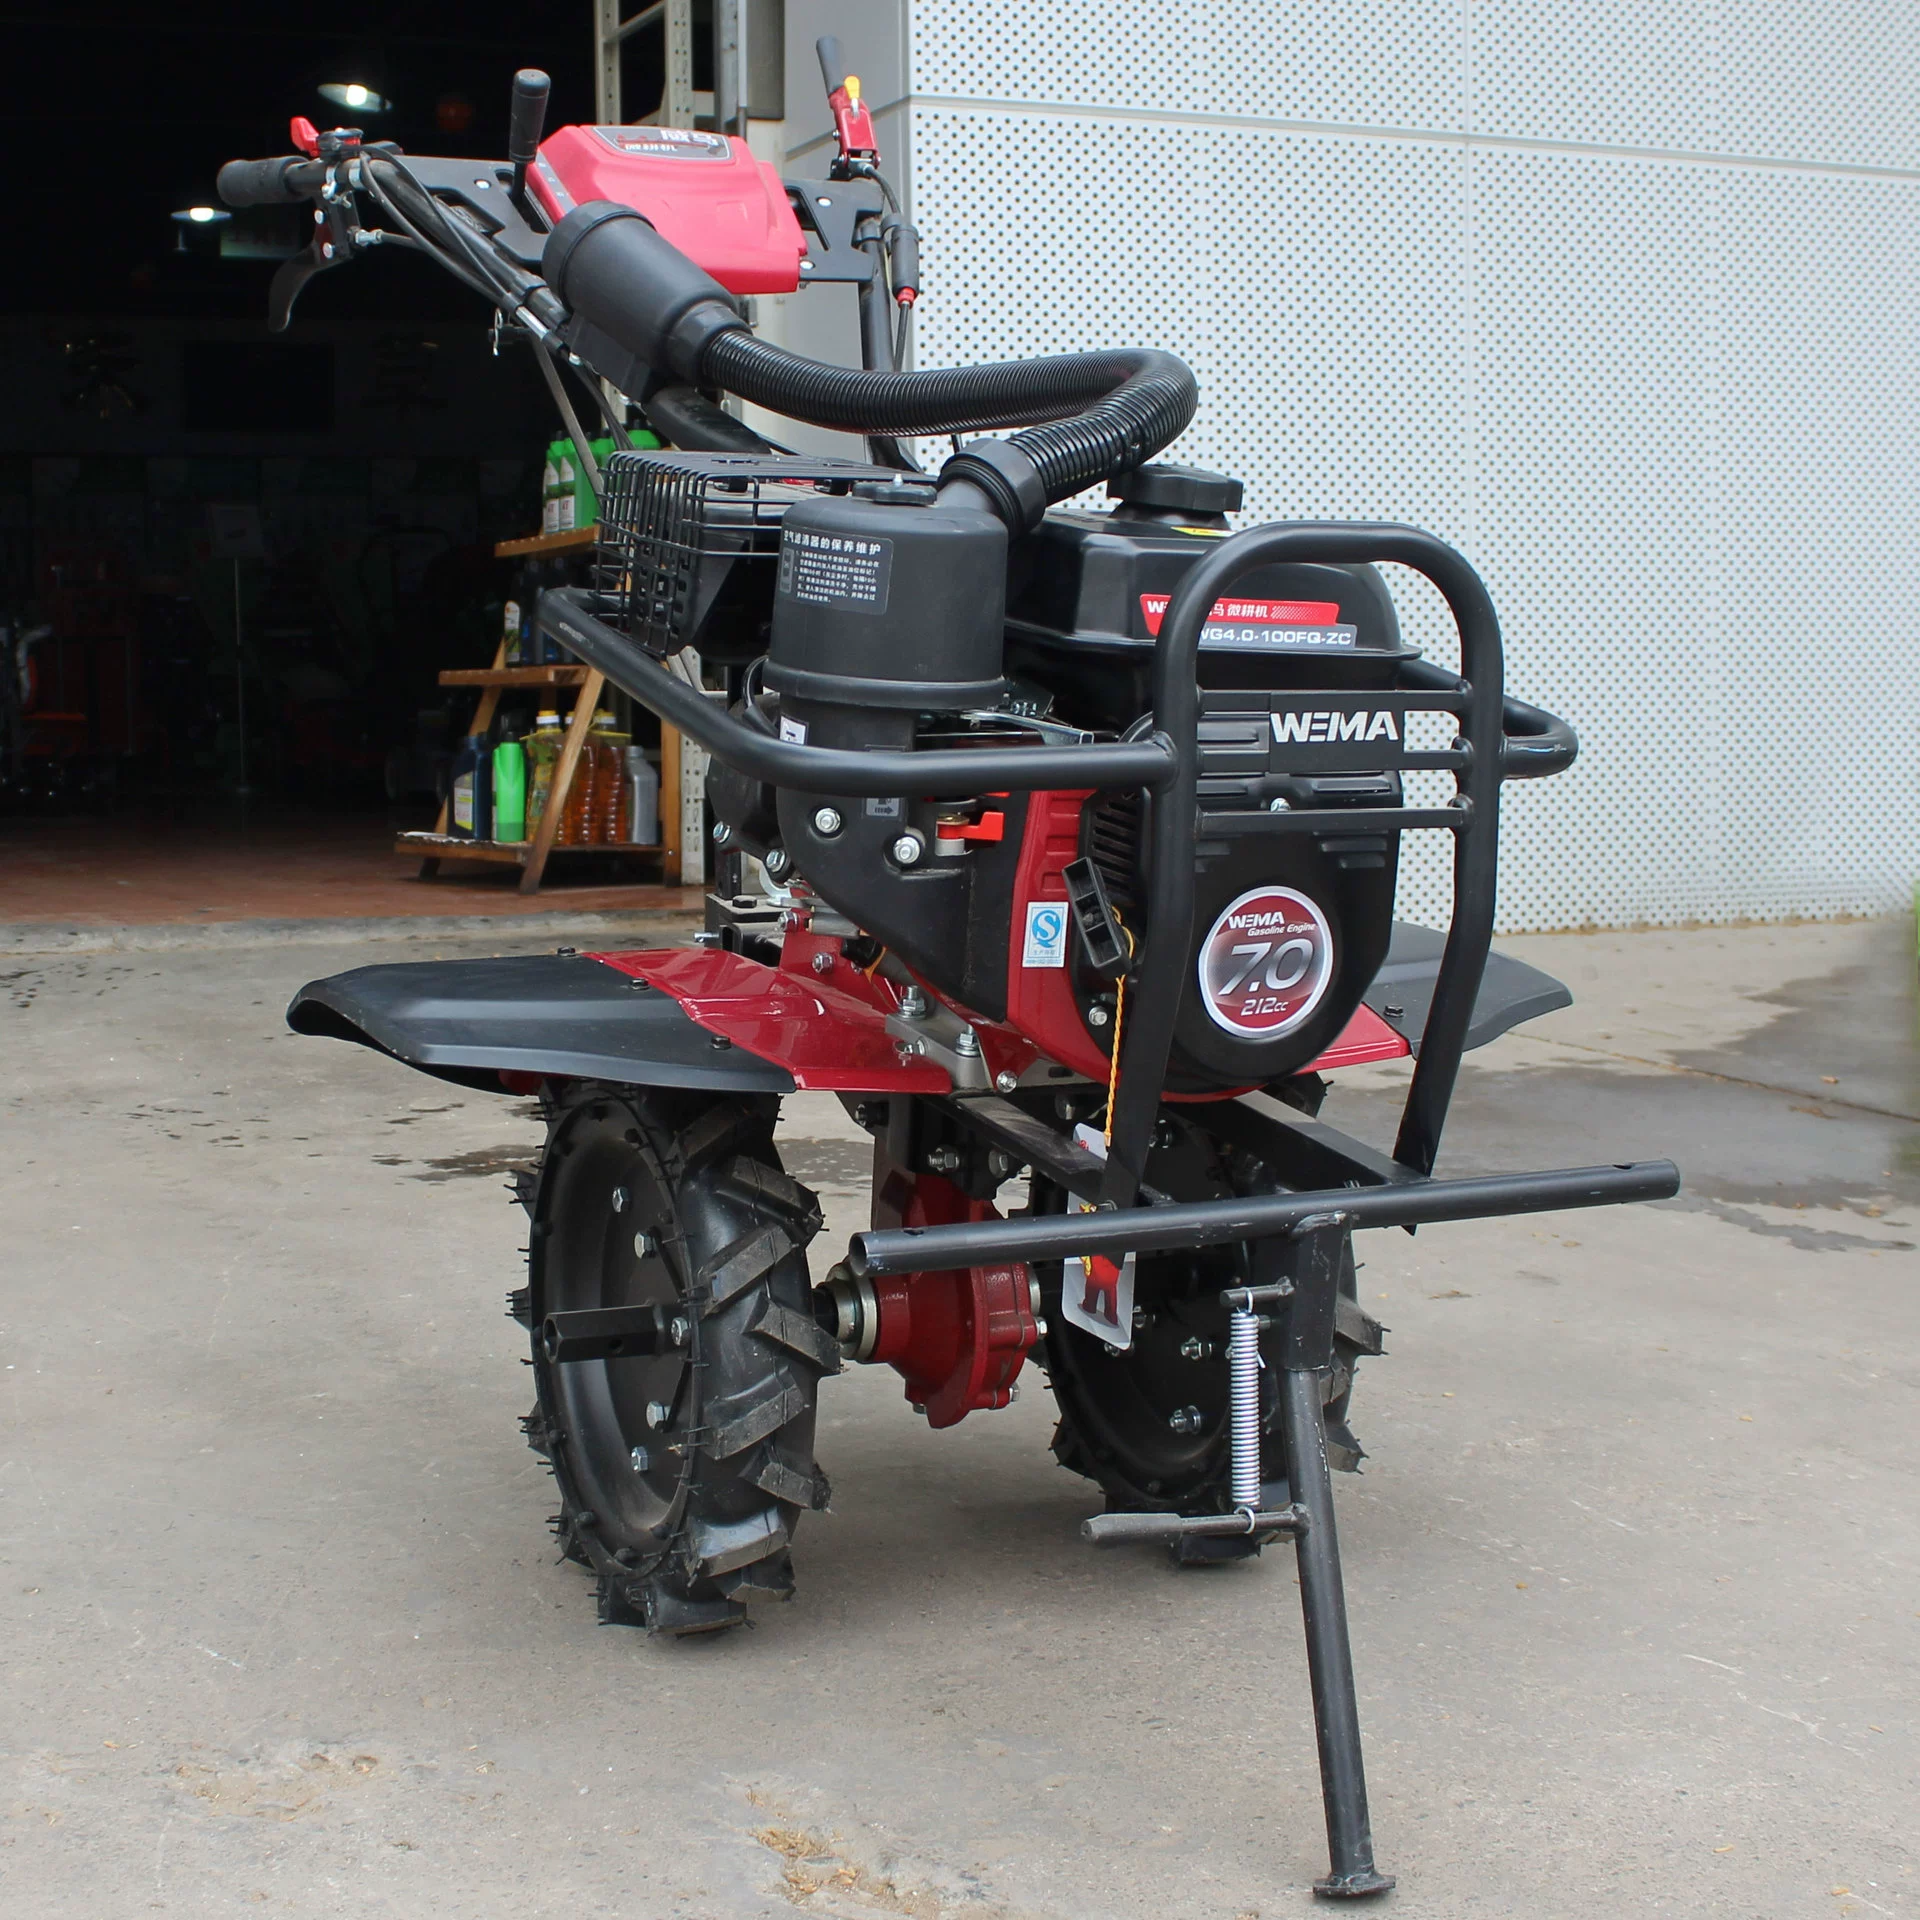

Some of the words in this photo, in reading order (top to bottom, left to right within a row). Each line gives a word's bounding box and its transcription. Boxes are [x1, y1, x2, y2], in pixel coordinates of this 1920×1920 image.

[1227, 604, 1268, 618] 微耕机
[1247, 925, 1285, 937] Gasoline
[1287, 922, 1317, 934] Engine
[1218, 938, 1314, 996] 7.0
[1241, 997, 1289, 1016] 212cc
